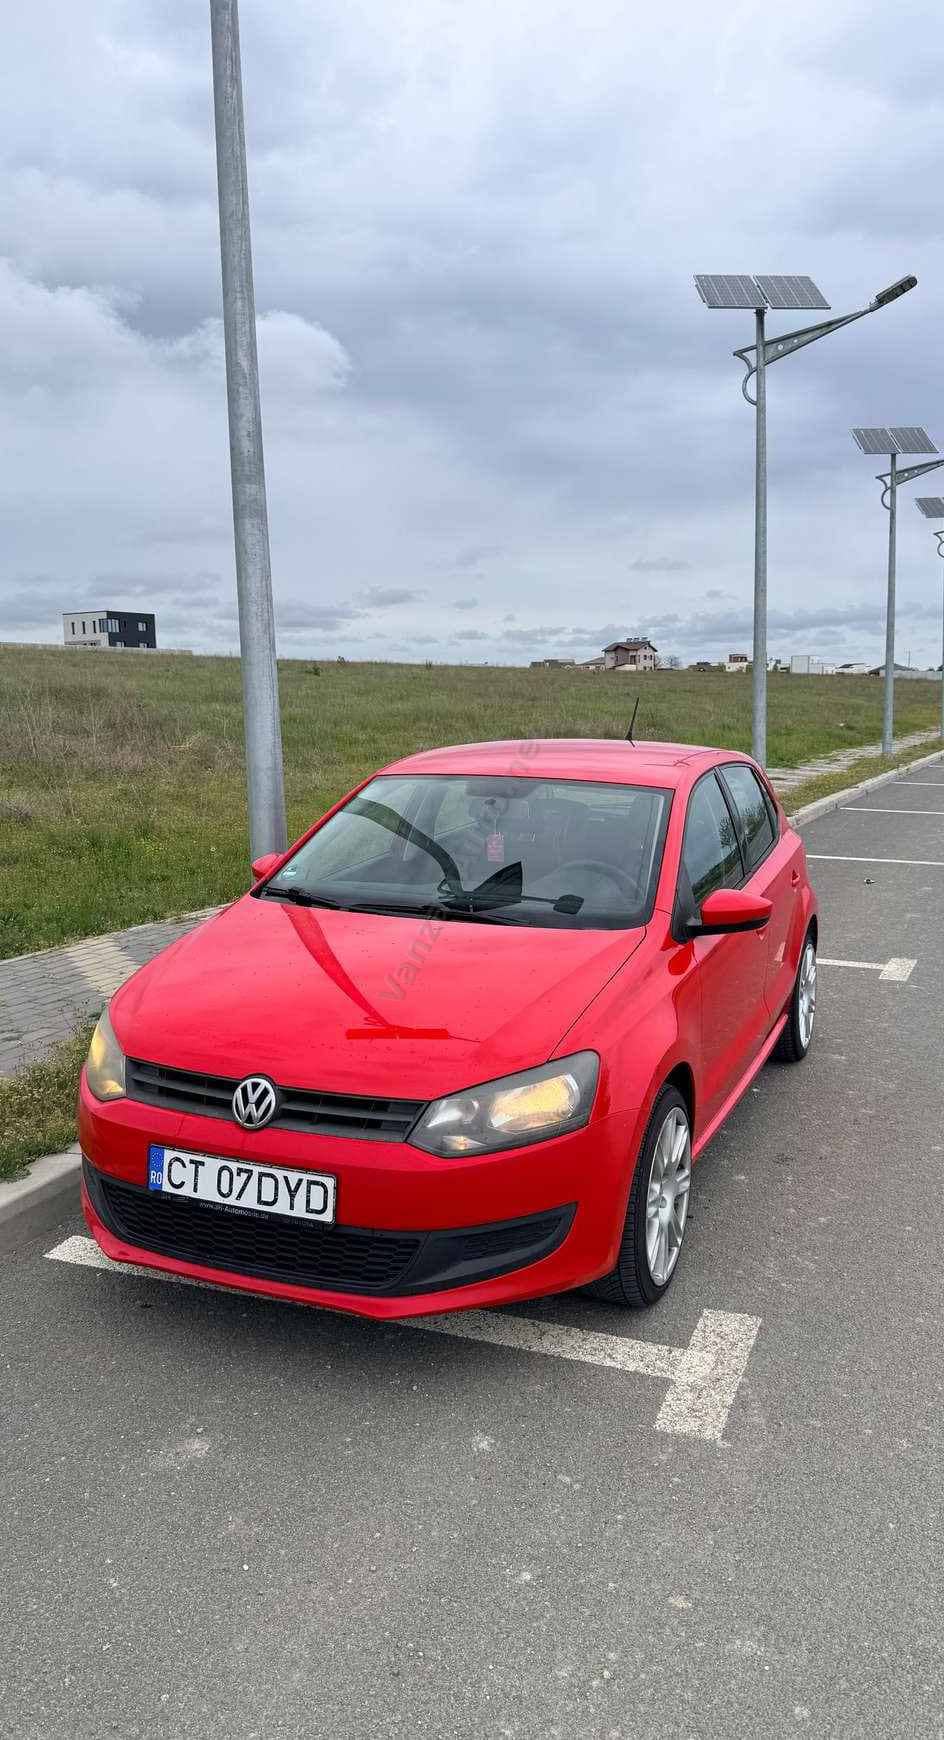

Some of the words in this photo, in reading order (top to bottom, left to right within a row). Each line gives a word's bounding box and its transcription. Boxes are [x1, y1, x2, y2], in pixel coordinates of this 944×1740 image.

[234, 1079, 275, 1127] VW
[150, 1170, 163, 1185] RO
[167, 1156, 205, 1193] CT
[216, 1164, 329, 1215] 07DYD
